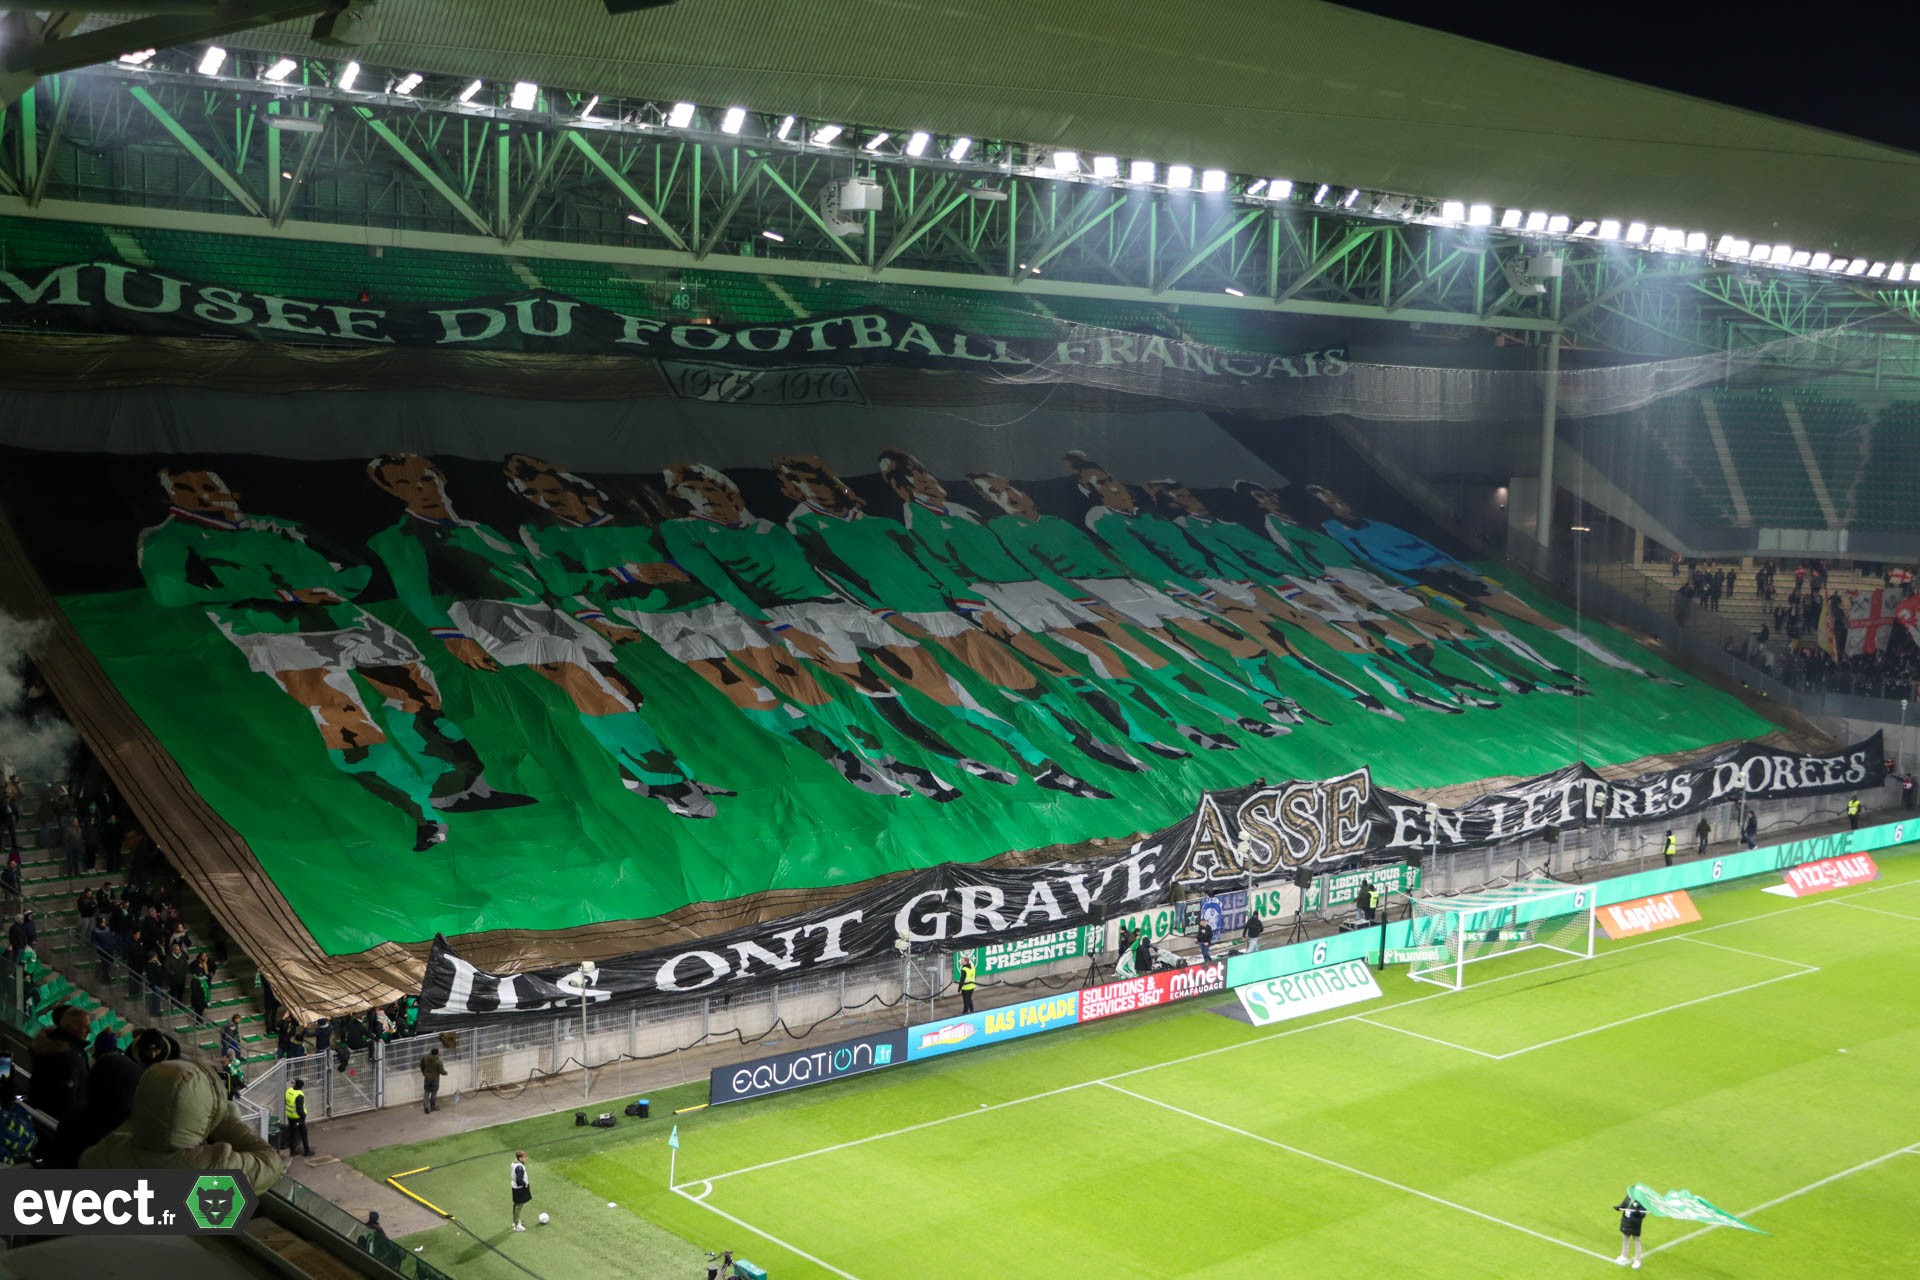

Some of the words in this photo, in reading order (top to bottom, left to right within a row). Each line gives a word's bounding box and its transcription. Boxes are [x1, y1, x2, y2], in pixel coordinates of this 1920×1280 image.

[0, 262, 396, 343] MUSEE
[433, 299, 580, 345] DU
[613, 313, 1031, 365] FOOTBALL
[672, 294, 690, 310] 48
[1775, 832, 1854, 869] MAXIME
[656, 909, 863, 992] ONT
[895, 841, 1162, 942] GRAVÉ
[1172, 767, 1371, 885] ASSE
[1386, 804, 1466, 848] EN
[1486, 773, 1692, 840] LETTRES
[1374, 868, 1400, 882] POUR
[1712, 861, 1723, 879] 6
[1329, 889, 1351, 904] LES
[1608, 895, 1680, 931] Kapriol
[1313, 941, 1327, 965] 6
[1083, 978, 1144, 1005] SOLUTIONS
[1147, 976, 1155, 991] &
[1169, 982, 1223, 1000] ECHAFAUDAGE
[1267, 963, 1369, 1005] sermaco
[985, 1010, 1015, 1035] BAS
[1019, 997, 1076, 1028] FAÇADE
[1082, 996, 1136, 1020] SERVICES
